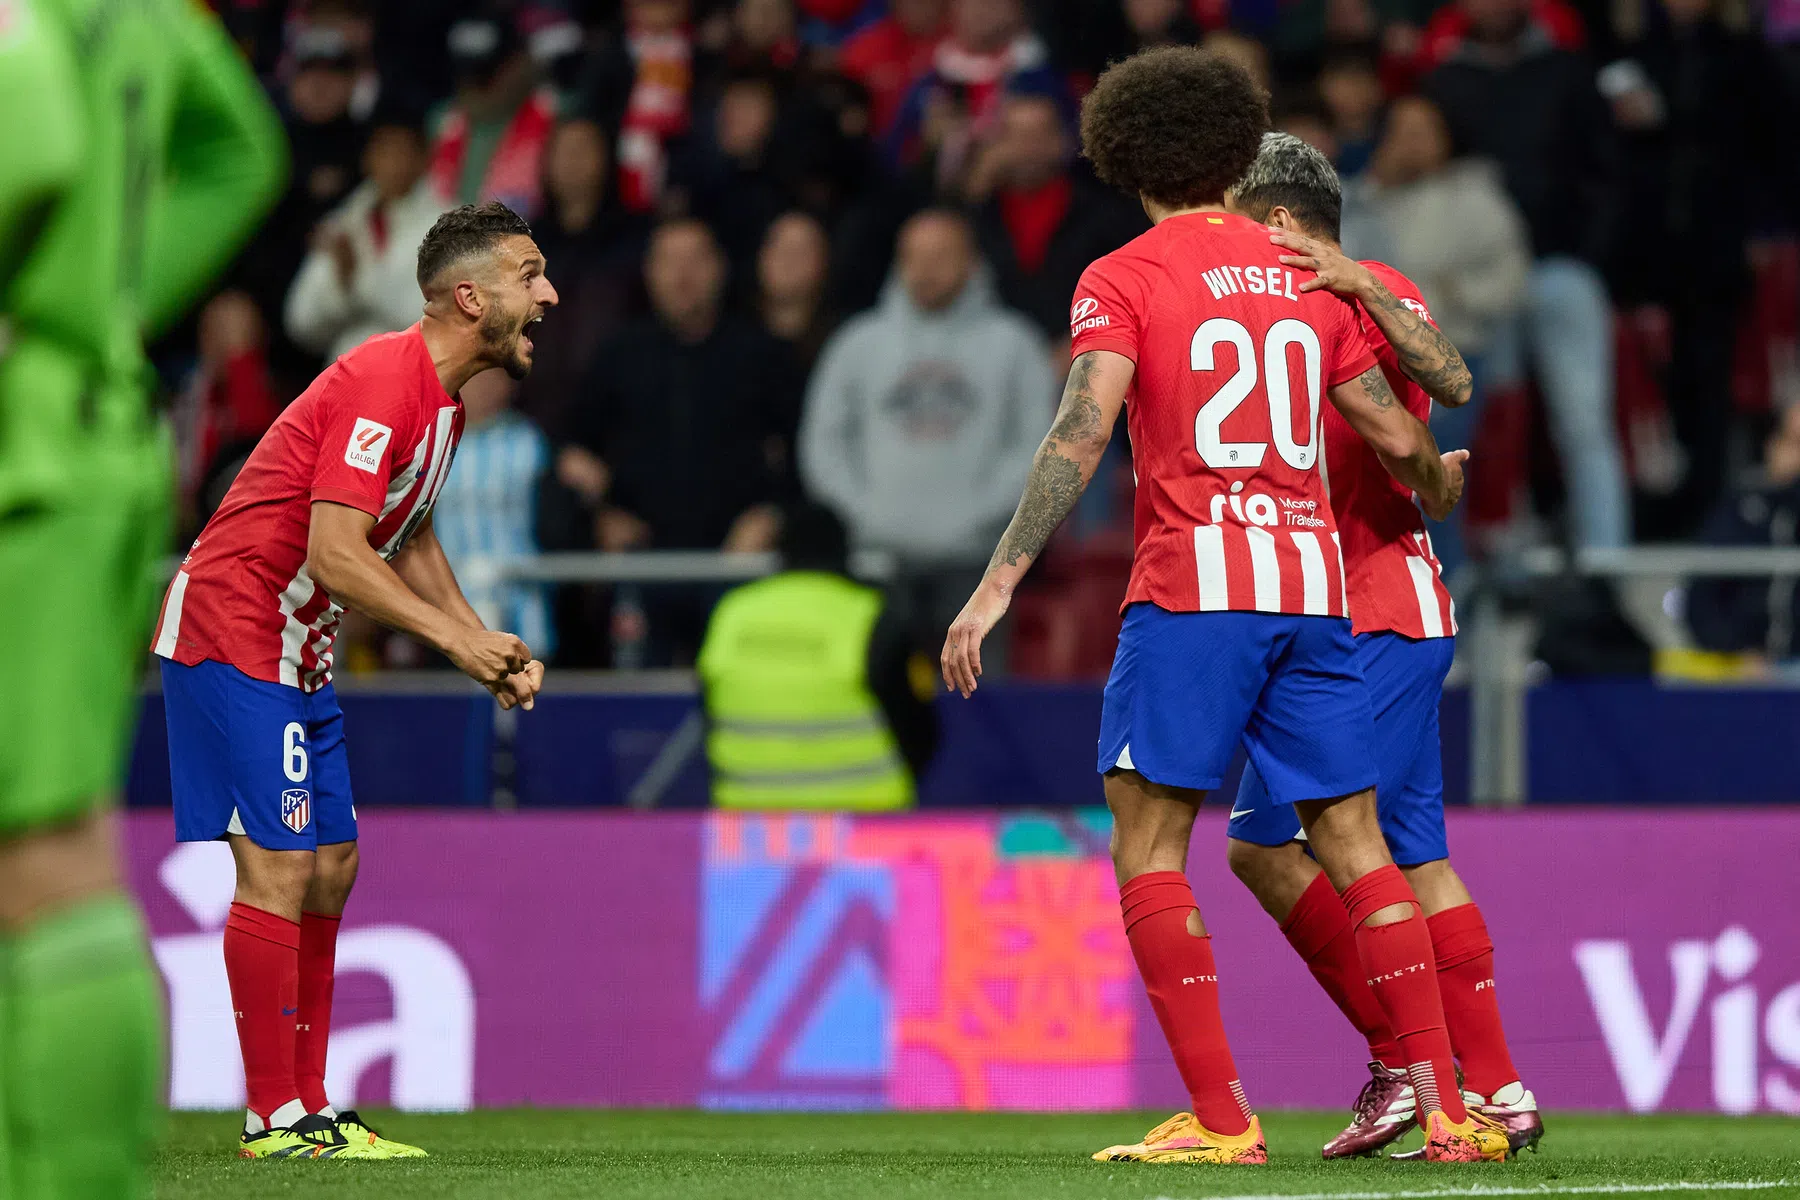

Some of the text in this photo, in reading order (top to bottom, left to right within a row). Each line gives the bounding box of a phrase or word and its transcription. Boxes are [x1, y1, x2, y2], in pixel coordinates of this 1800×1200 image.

[1201, 265, 1298, 302] WITSEL
[1190, 317, 1322, 470] 20
[350, 451, 376, 466] LALIGA
[1210, 480, 1278, 526] ria
[283, 721, 308, 782] 6
[1366, 962, 1426, 987] ATLETI
